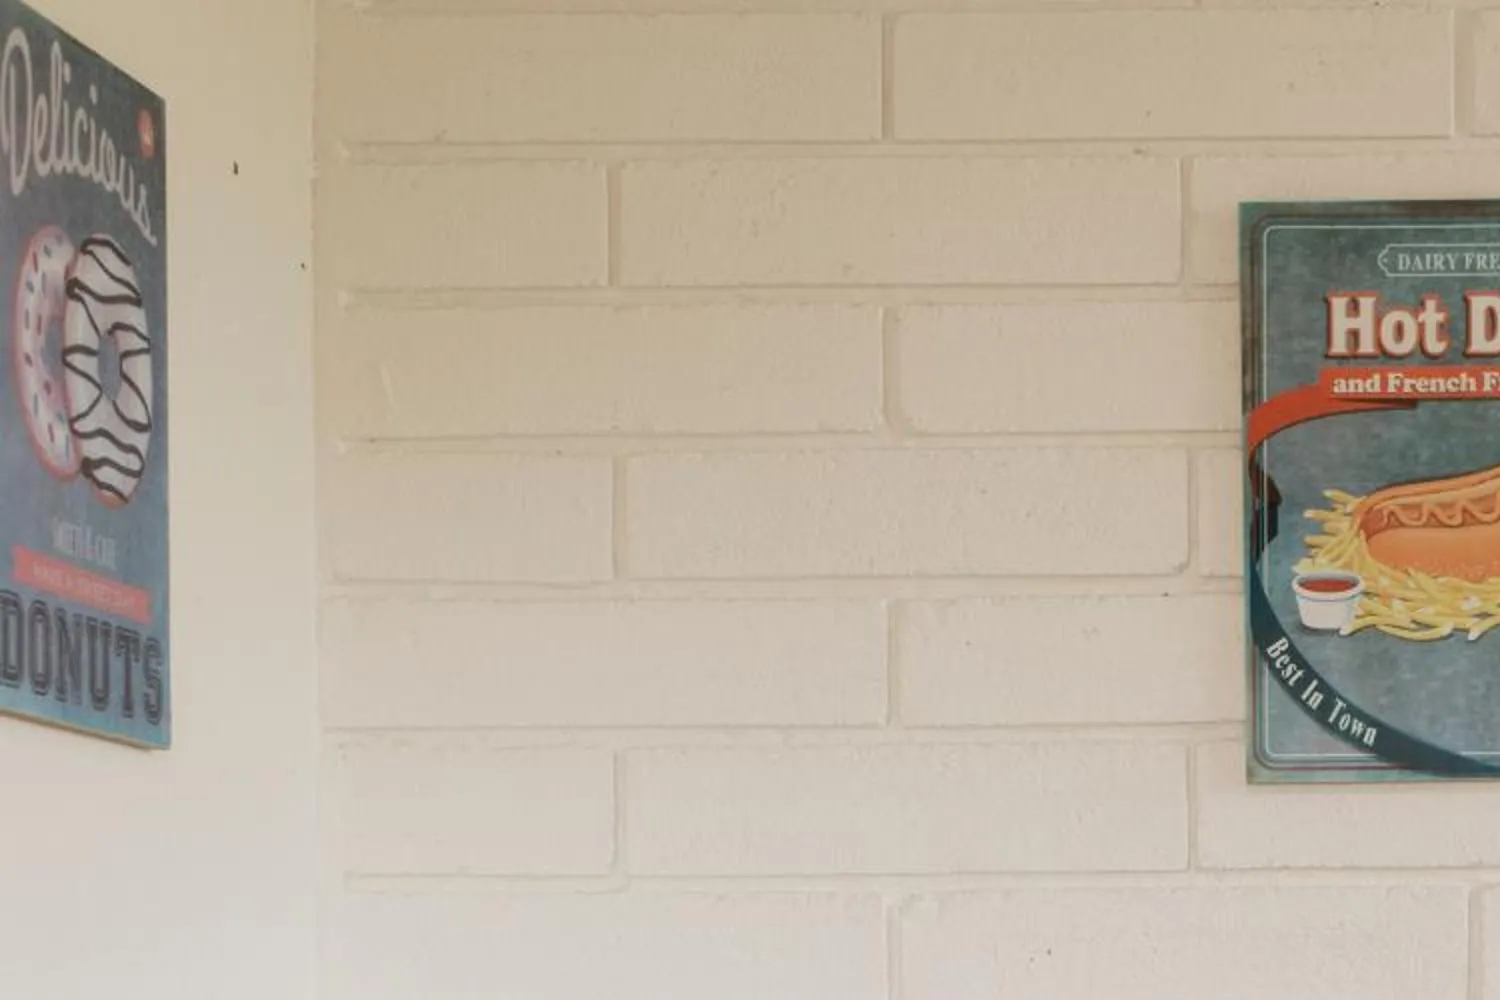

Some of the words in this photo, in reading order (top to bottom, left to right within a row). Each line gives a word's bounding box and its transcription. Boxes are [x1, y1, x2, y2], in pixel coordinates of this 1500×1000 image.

[1, 27, 158, 247] Delicious
[1398, 253, 1460, 271] DAIRY
[1327, 292, 1450, 357] Hot
[1333, 373, 1380, 393] and
[1387, 372, 1477, 394] French
[0, 588, 163, 726] DONUTS
[1266, 637, 1305, 687] Best
[1301, 679, 1324, 711] In
[1327, 697, 1377, 747] Town
